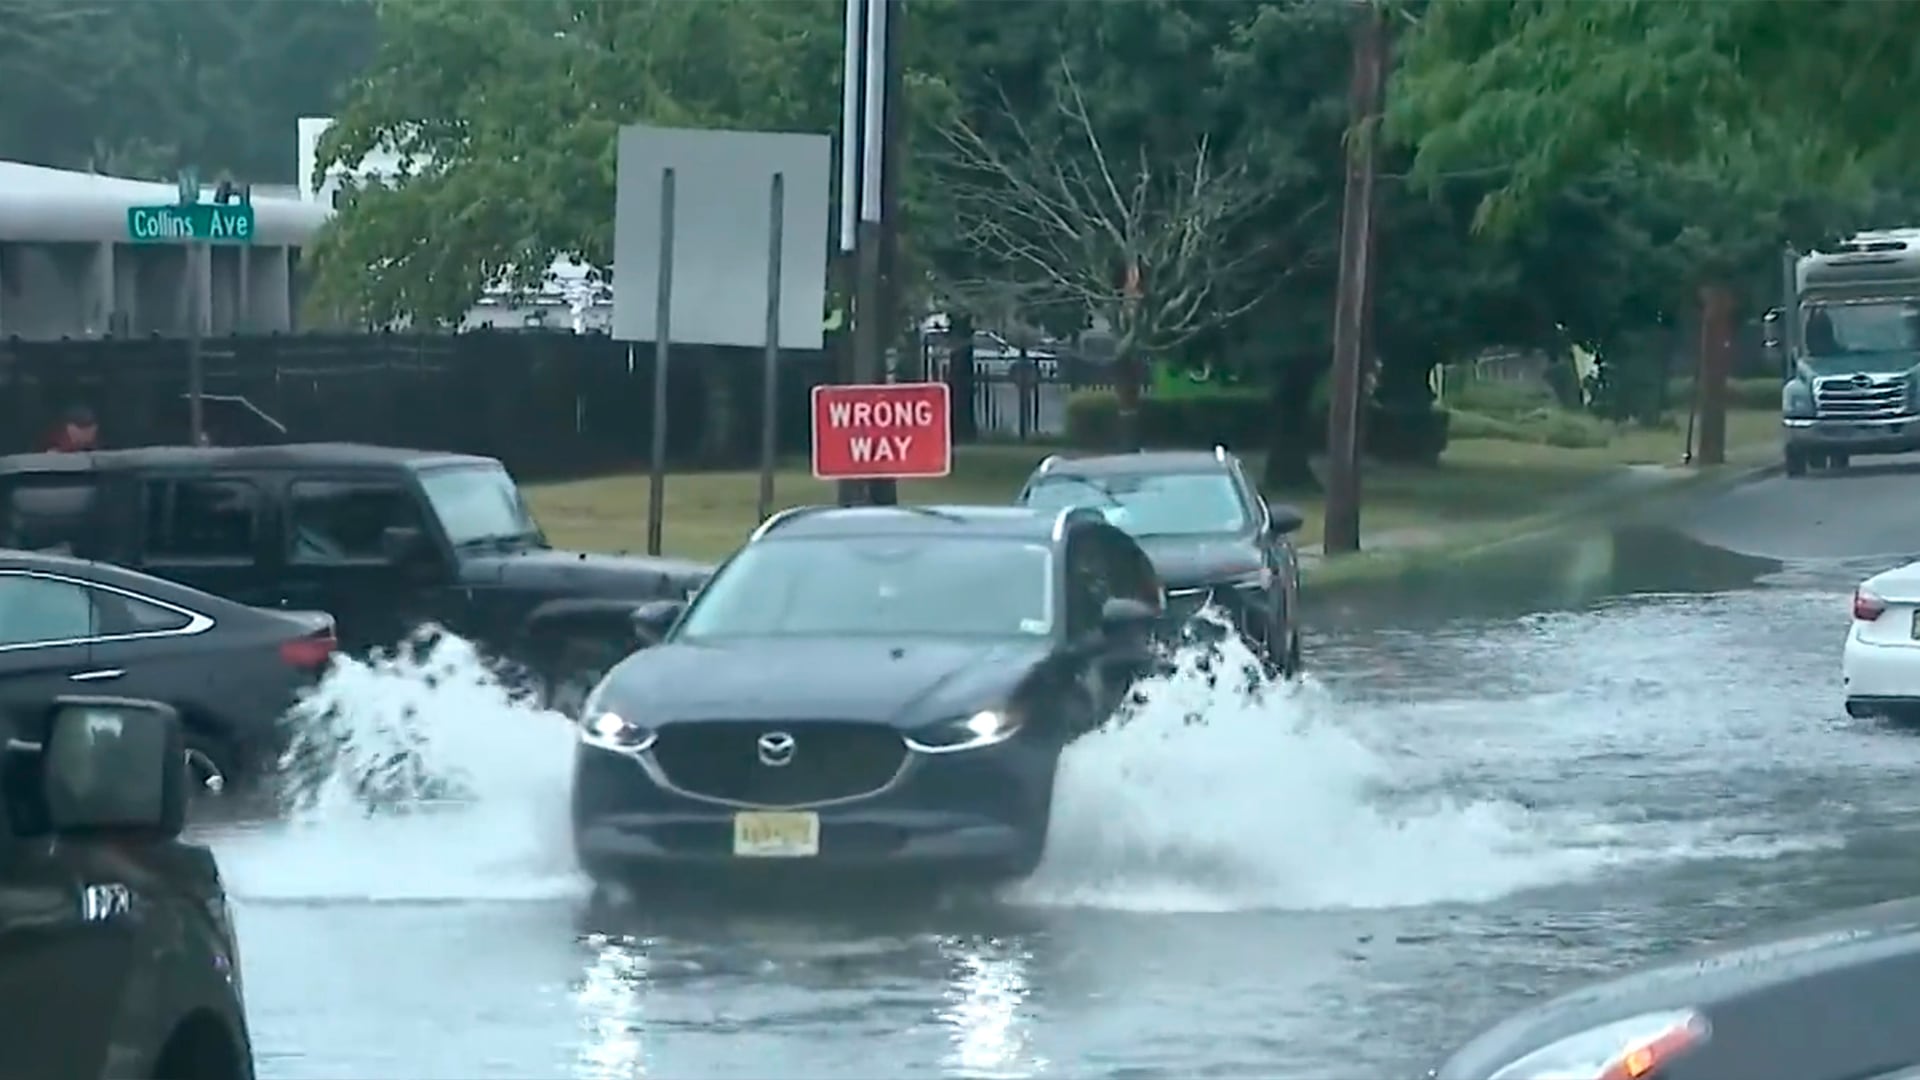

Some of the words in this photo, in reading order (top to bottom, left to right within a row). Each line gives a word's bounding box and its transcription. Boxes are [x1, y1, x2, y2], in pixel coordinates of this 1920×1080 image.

[133, 209, 194, 238] Collins
[210, 209, 248, 237] Ave
[828, 400, 933, 428] WRONG
[849, 435, 912, 463] WAY
